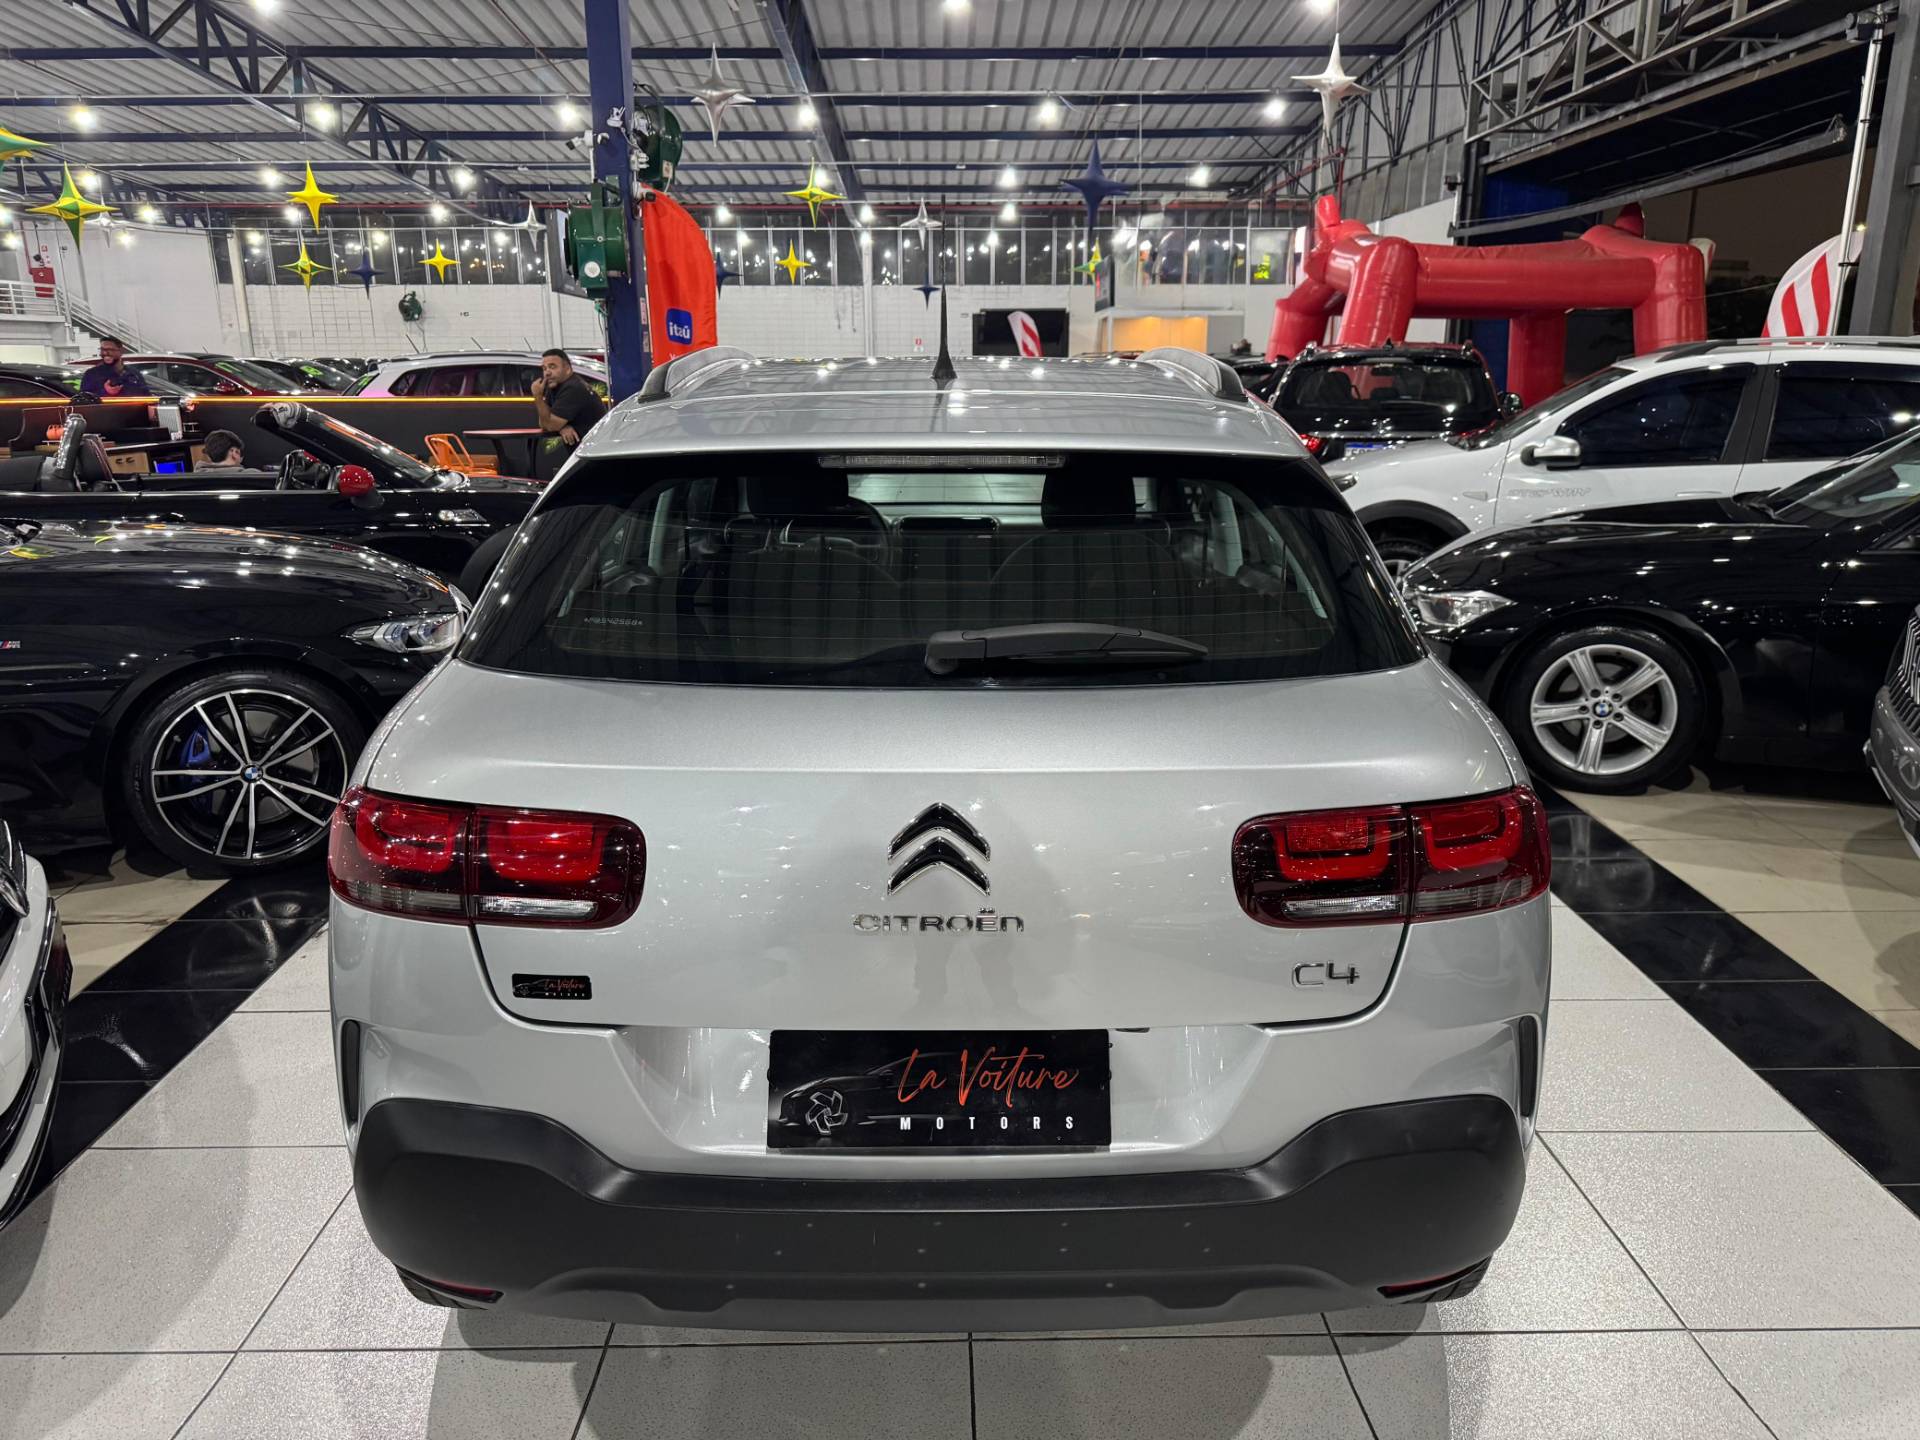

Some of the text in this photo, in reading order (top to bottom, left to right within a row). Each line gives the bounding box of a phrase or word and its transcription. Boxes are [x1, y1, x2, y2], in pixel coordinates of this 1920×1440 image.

[668, 321, 691, 340] itaú
[1291, 961, 1360, 986] C4
[897, 1046, 1079, 1108] La Voiture
[899, 1116, 1074, 1131] MOTORS
